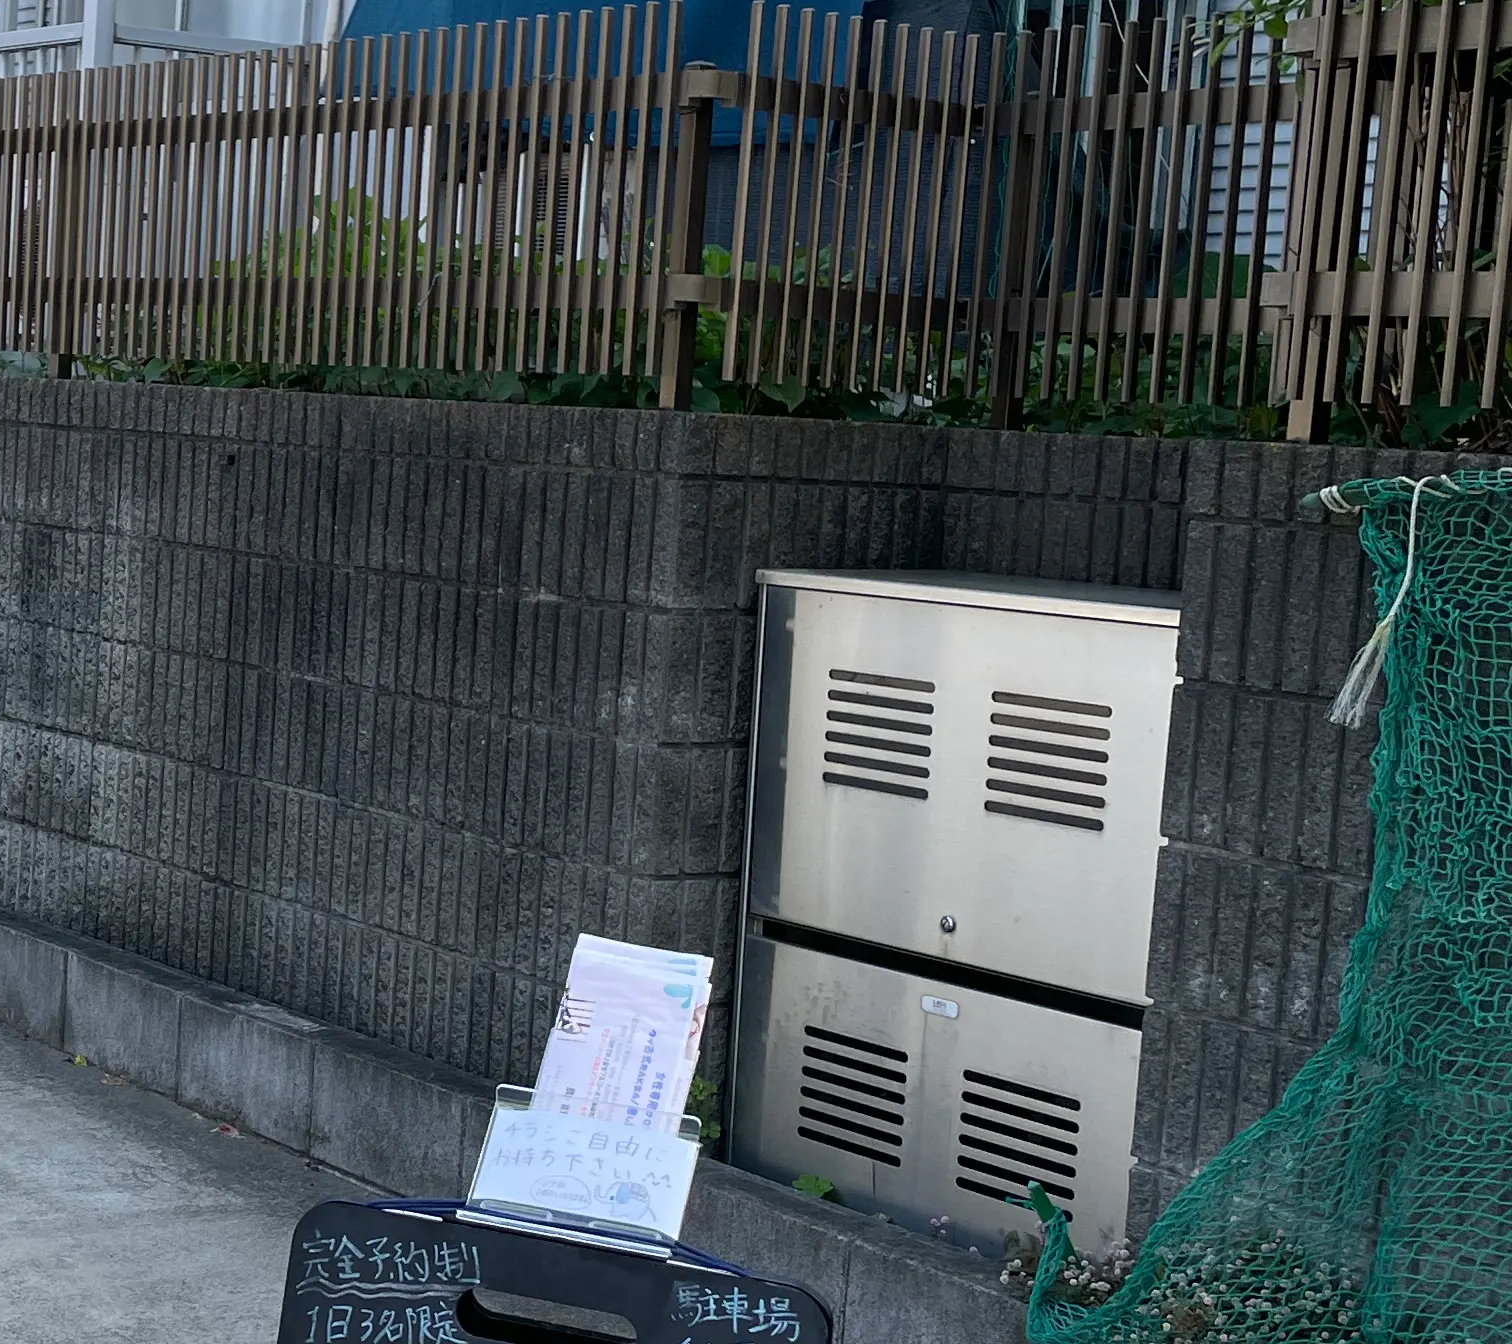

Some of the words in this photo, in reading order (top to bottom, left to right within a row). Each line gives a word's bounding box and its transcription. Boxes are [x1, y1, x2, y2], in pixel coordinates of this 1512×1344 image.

[303, 1235, 481, 1284] 完全予約制
[671, 1285, 801, 1343] 駐車場
